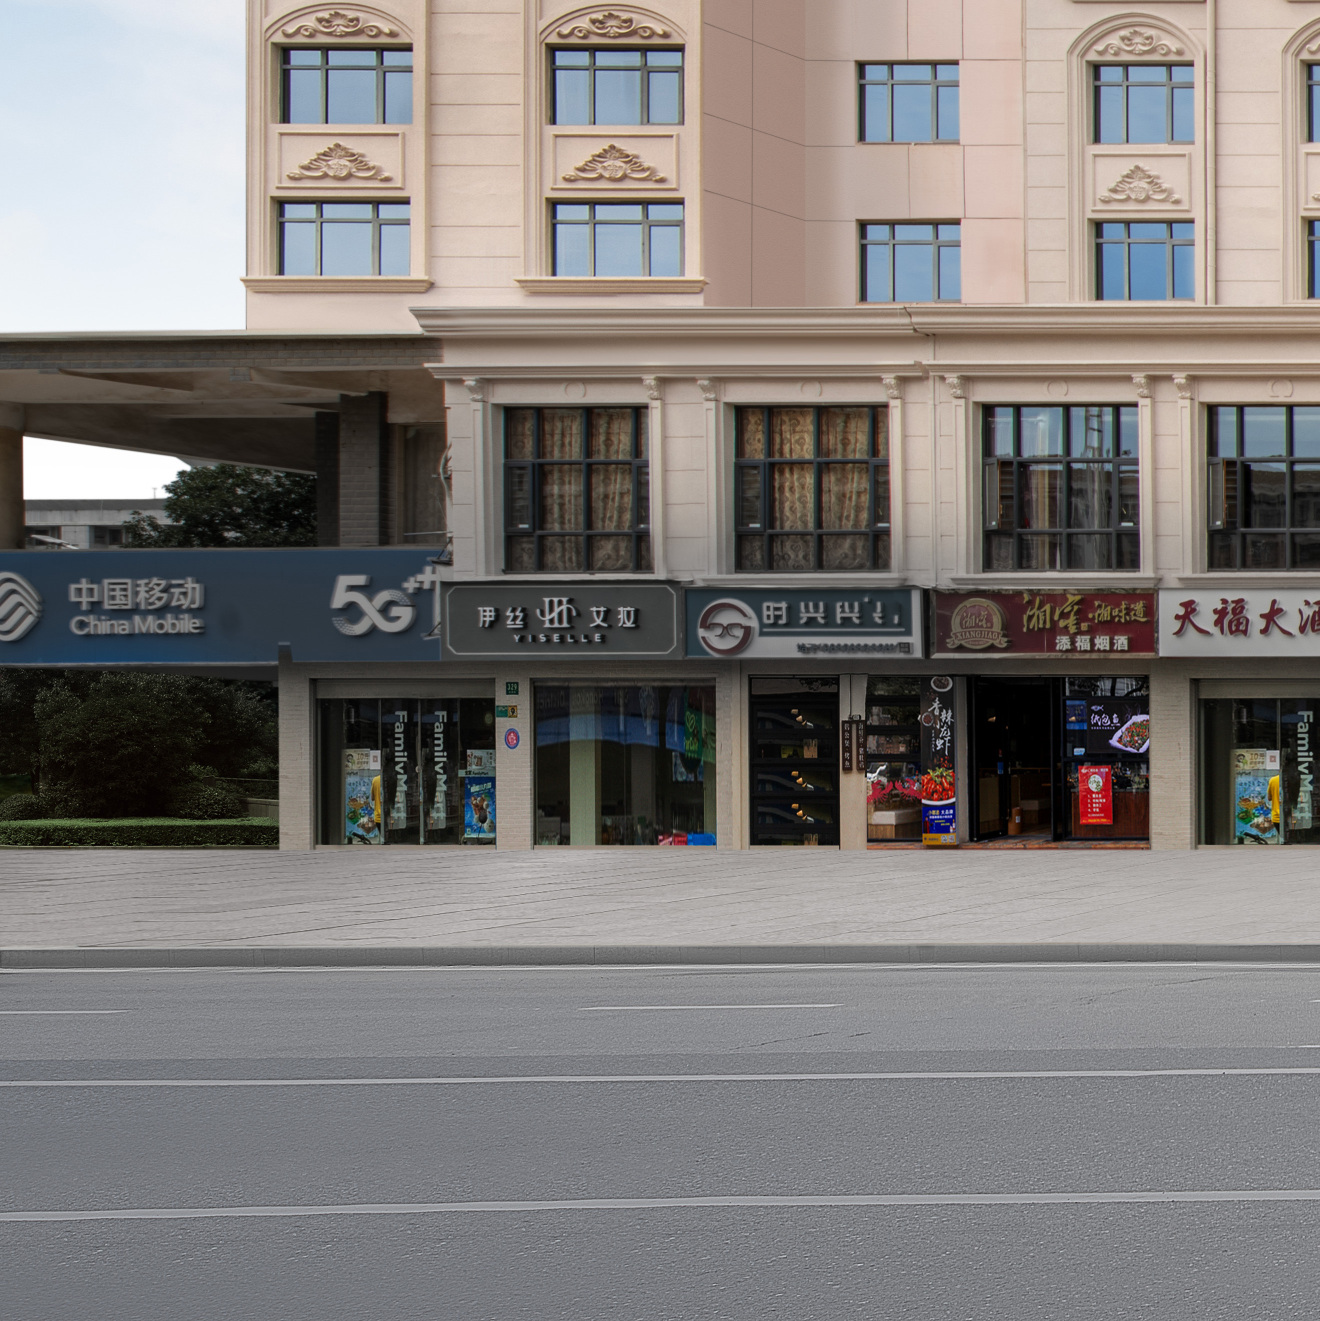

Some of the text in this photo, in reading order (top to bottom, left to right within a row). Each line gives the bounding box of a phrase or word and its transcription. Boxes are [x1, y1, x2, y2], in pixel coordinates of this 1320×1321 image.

[68, 577, 205, 611] 中国移动
[69, 614, 205, 635] China Mobile
[513, 633, 602, 643] YISELLE
[956, 630, 998, 640] XIANGJIAO
[1056, 635, 1129, 651] 添福烟酒
